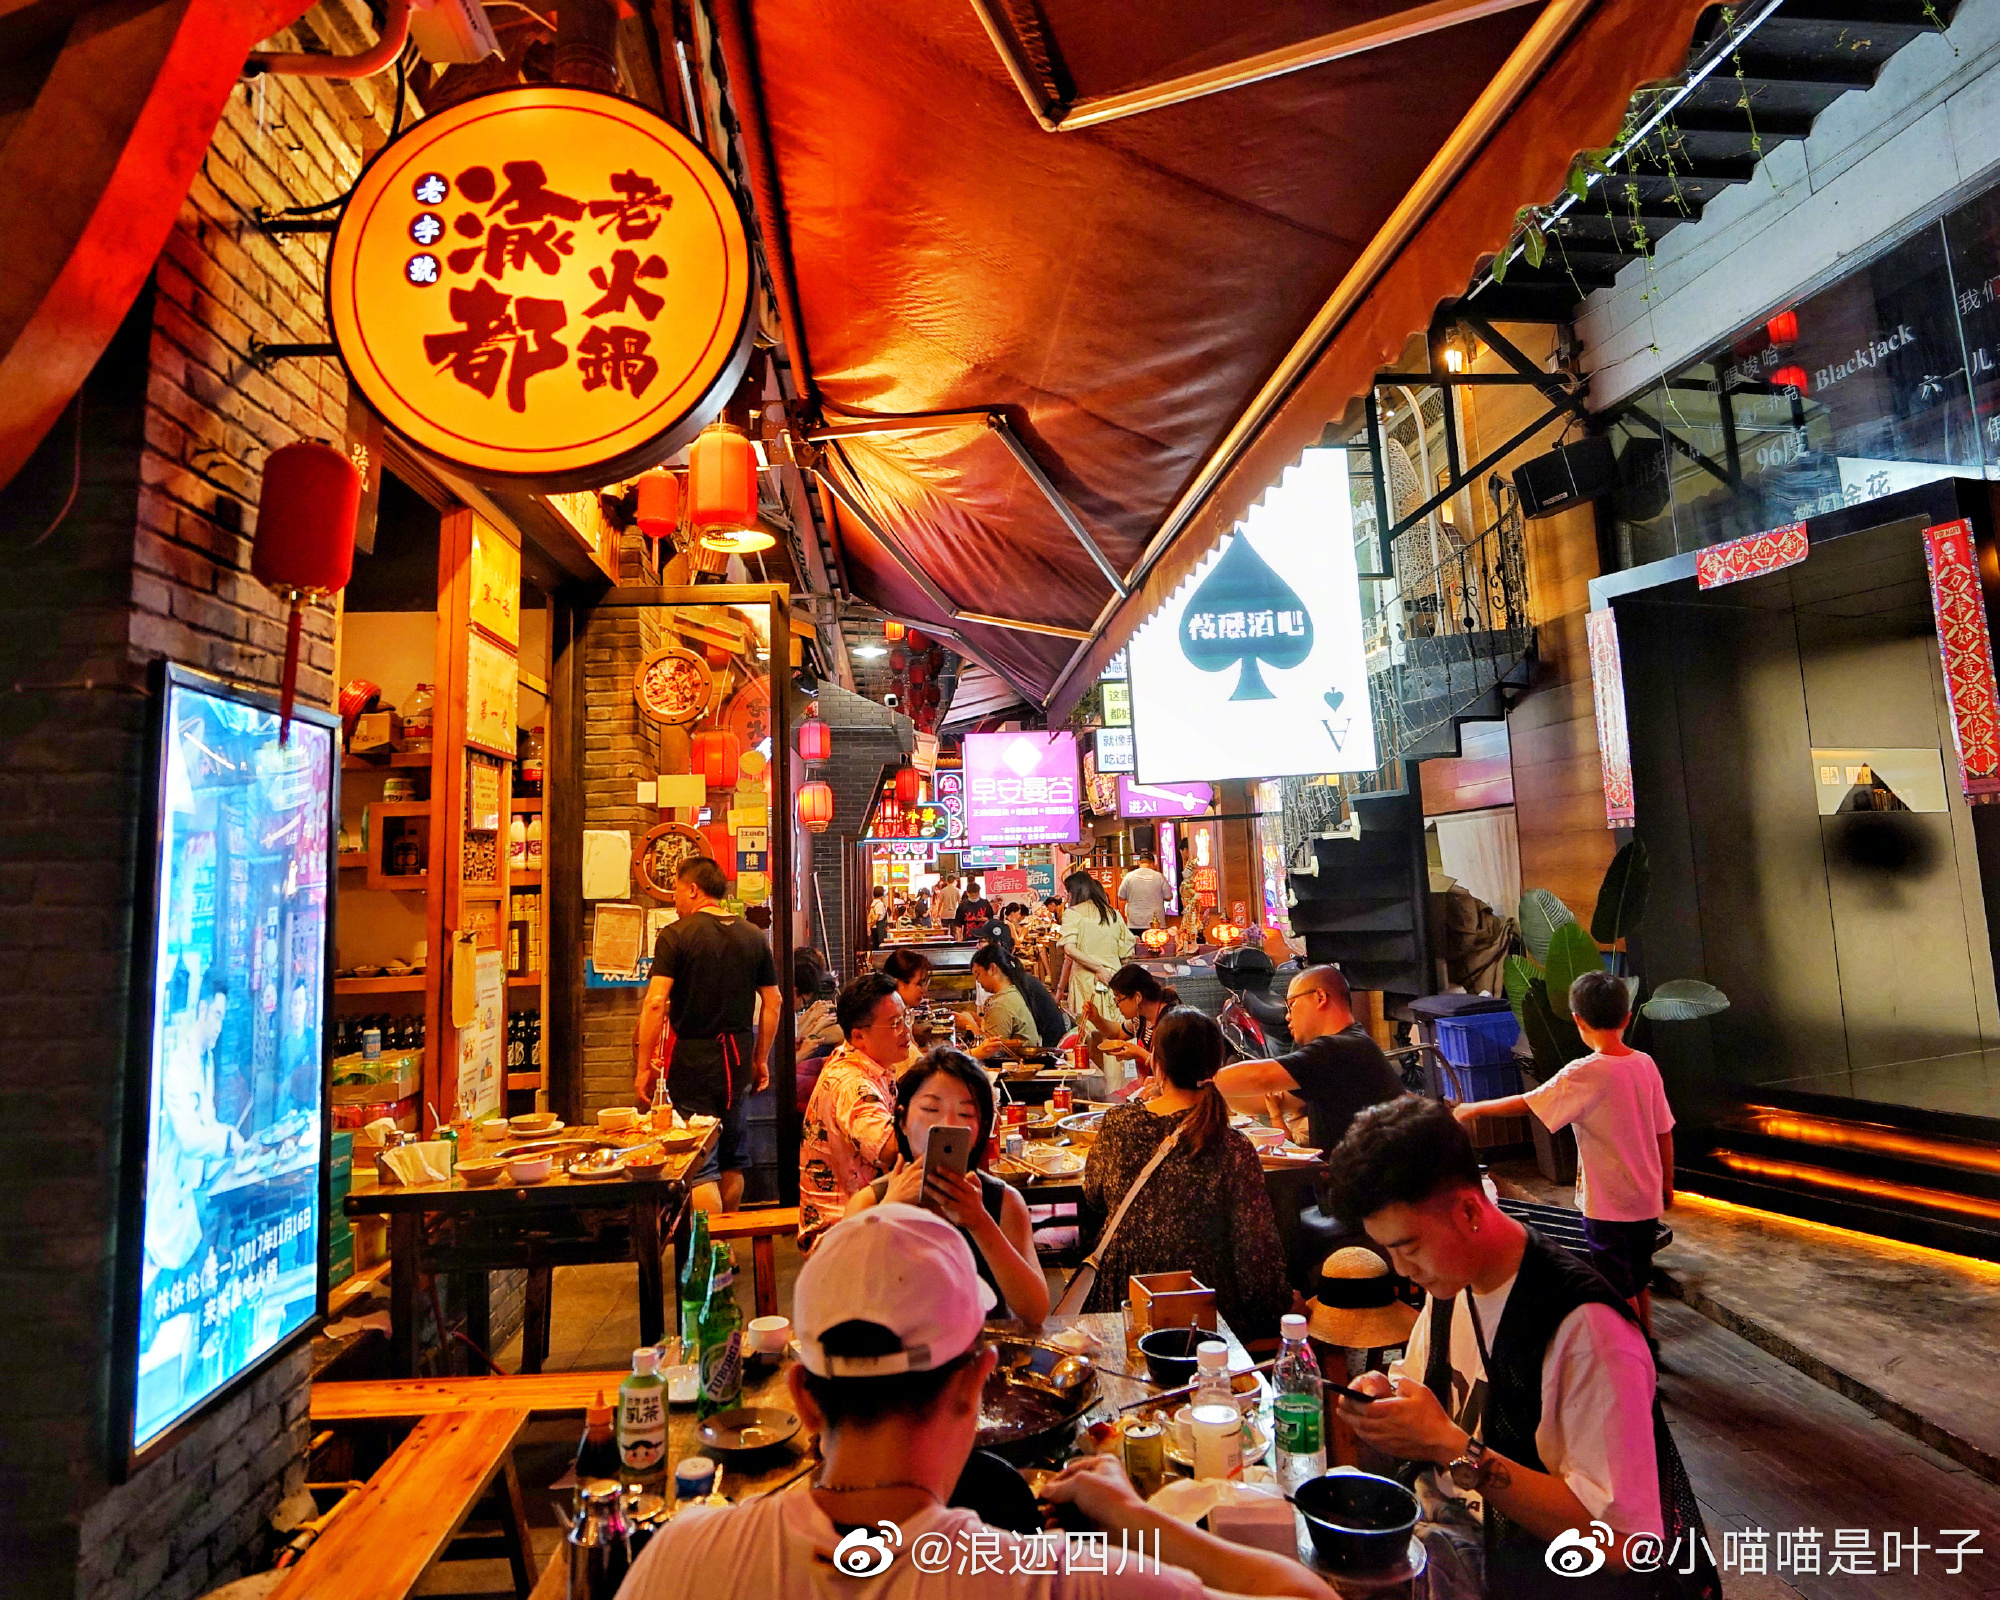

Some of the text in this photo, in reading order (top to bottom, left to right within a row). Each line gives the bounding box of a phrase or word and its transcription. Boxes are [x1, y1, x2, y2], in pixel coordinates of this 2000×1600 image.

[422, 160, 588, 413] 渝都
[1815, 324, 1916, 393] Blackjack
[971, 776, 1074, 806] 早安曼谷
[745, 853, 759, 867] 推
[707, 1344, 739, 1397] TUBORG
